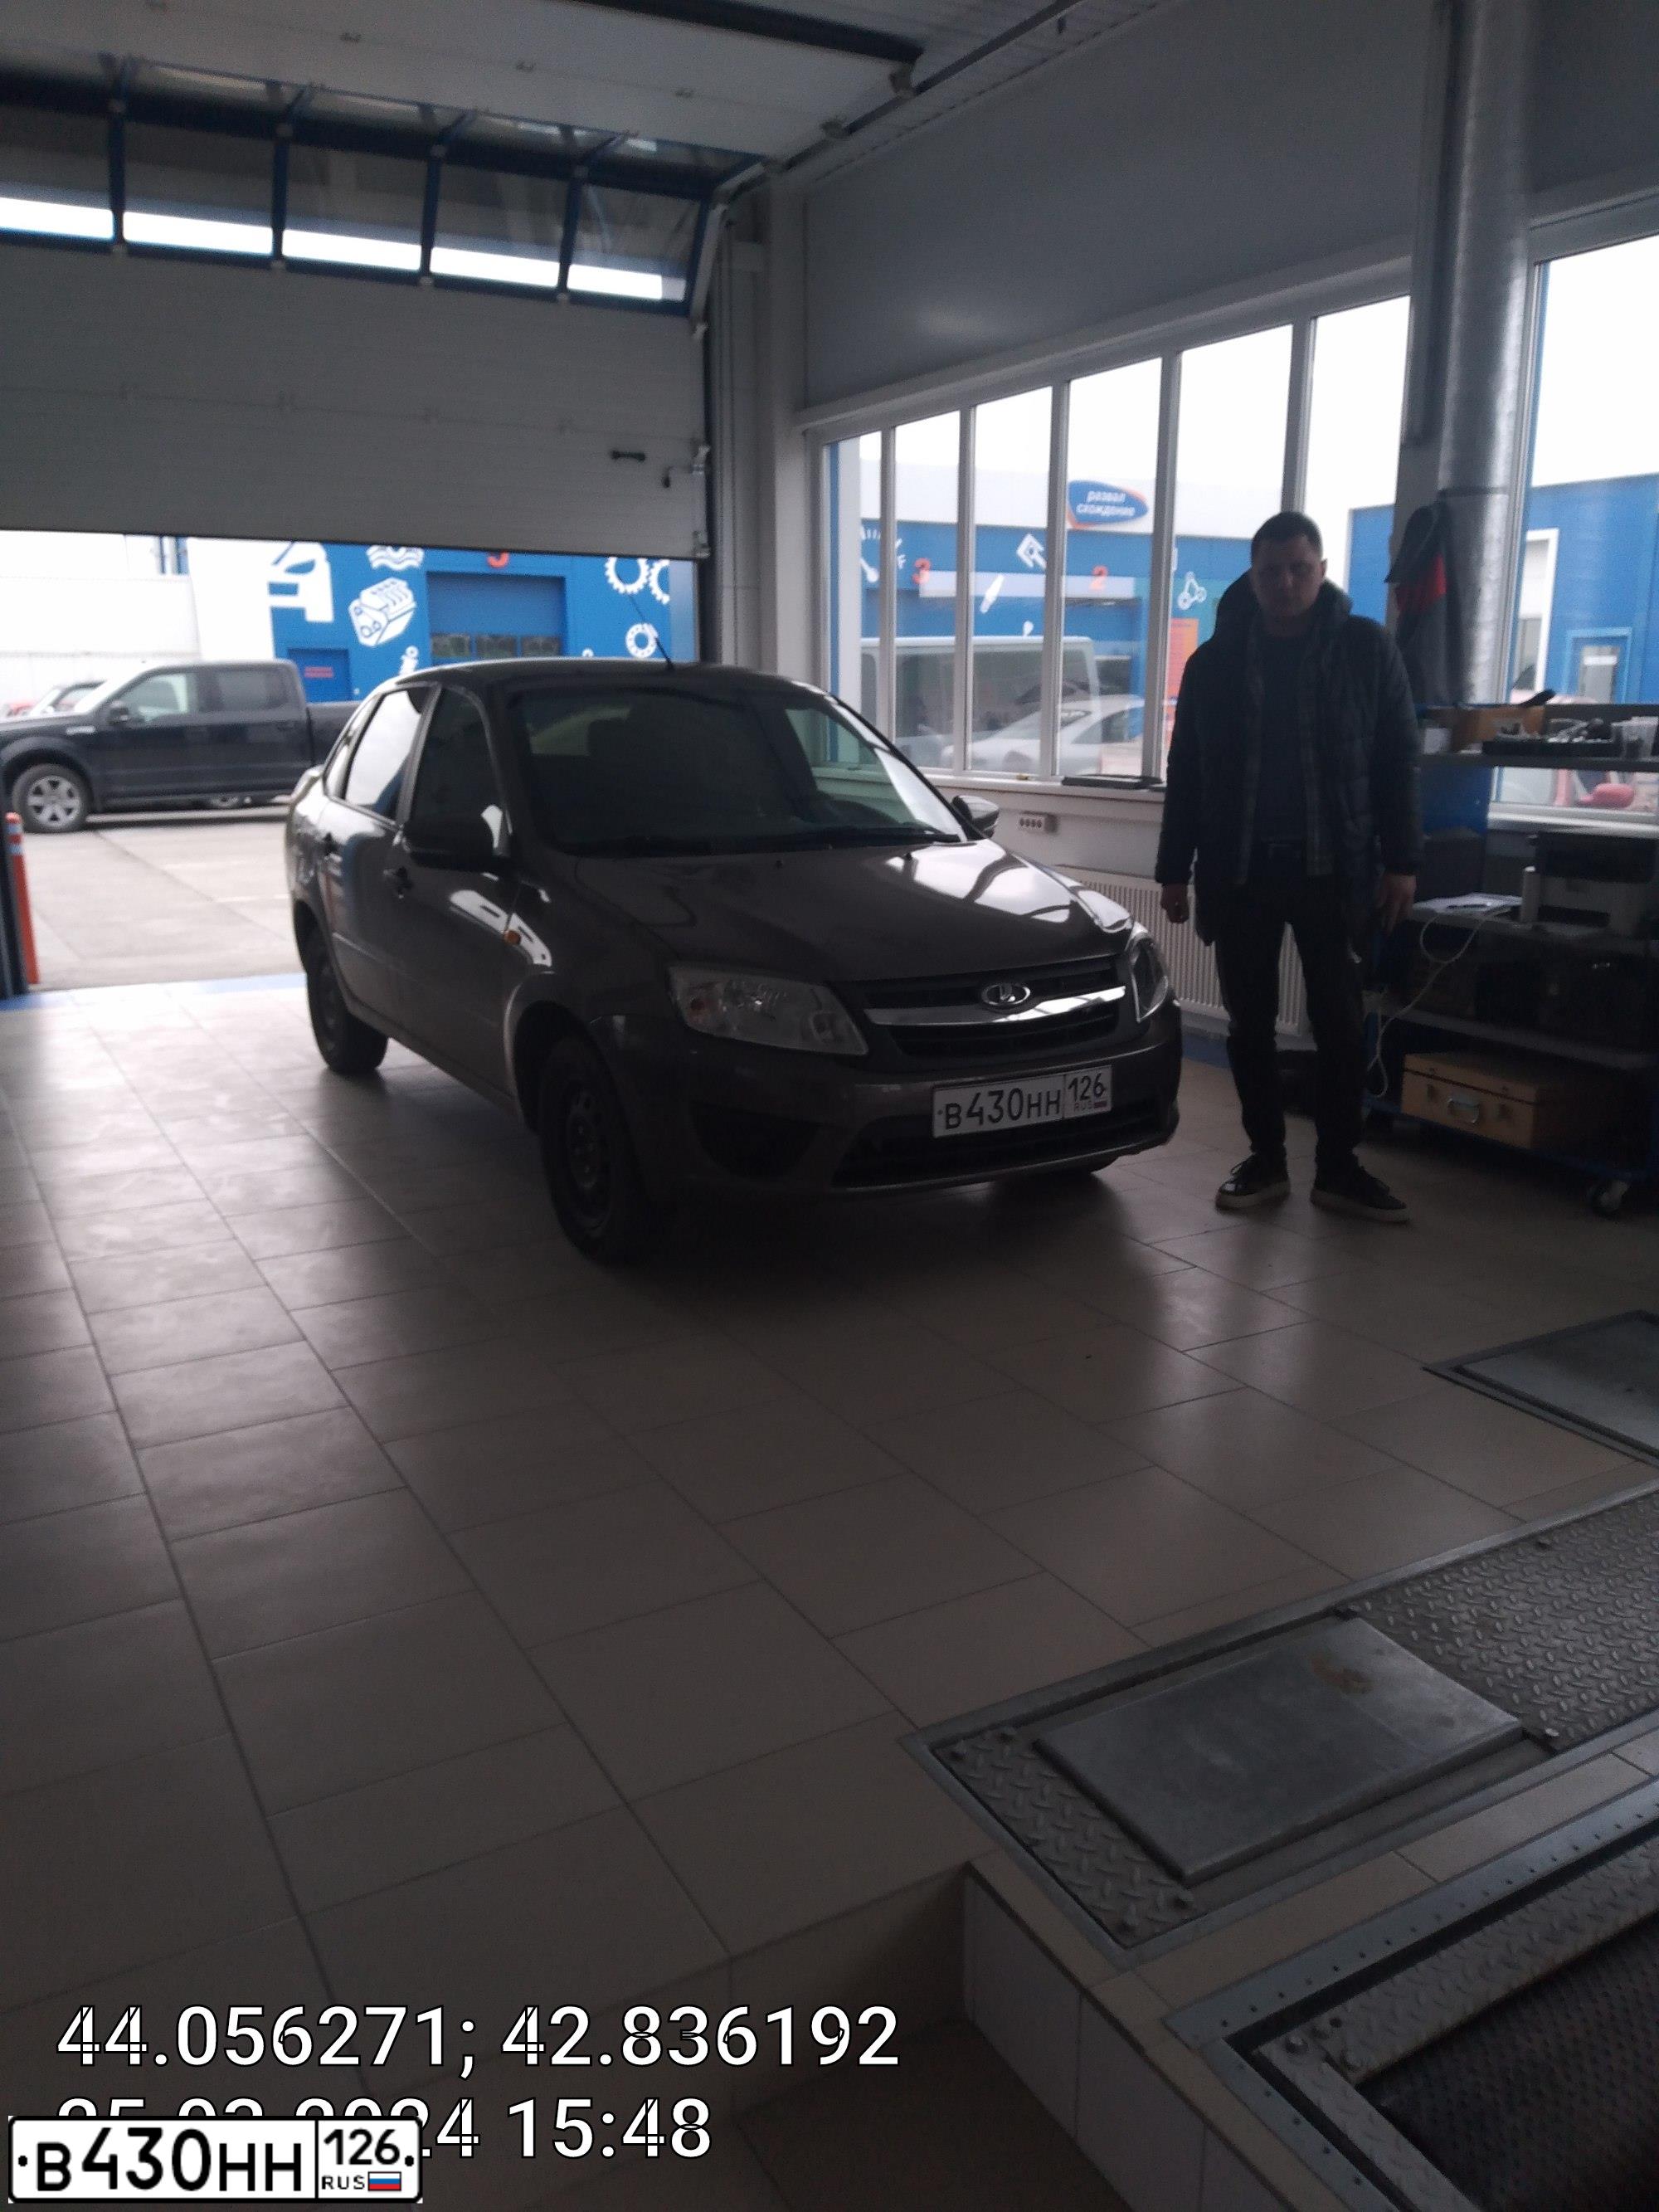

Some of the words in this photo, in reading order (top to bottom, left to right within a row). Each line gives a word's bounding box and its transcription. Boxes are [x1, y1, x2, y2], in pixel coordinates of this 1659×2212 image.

[912, 558, 931, 584] 3
[1088, 565, 1108, 591] 2
[1068, 1074, 1107, 1102] 126
